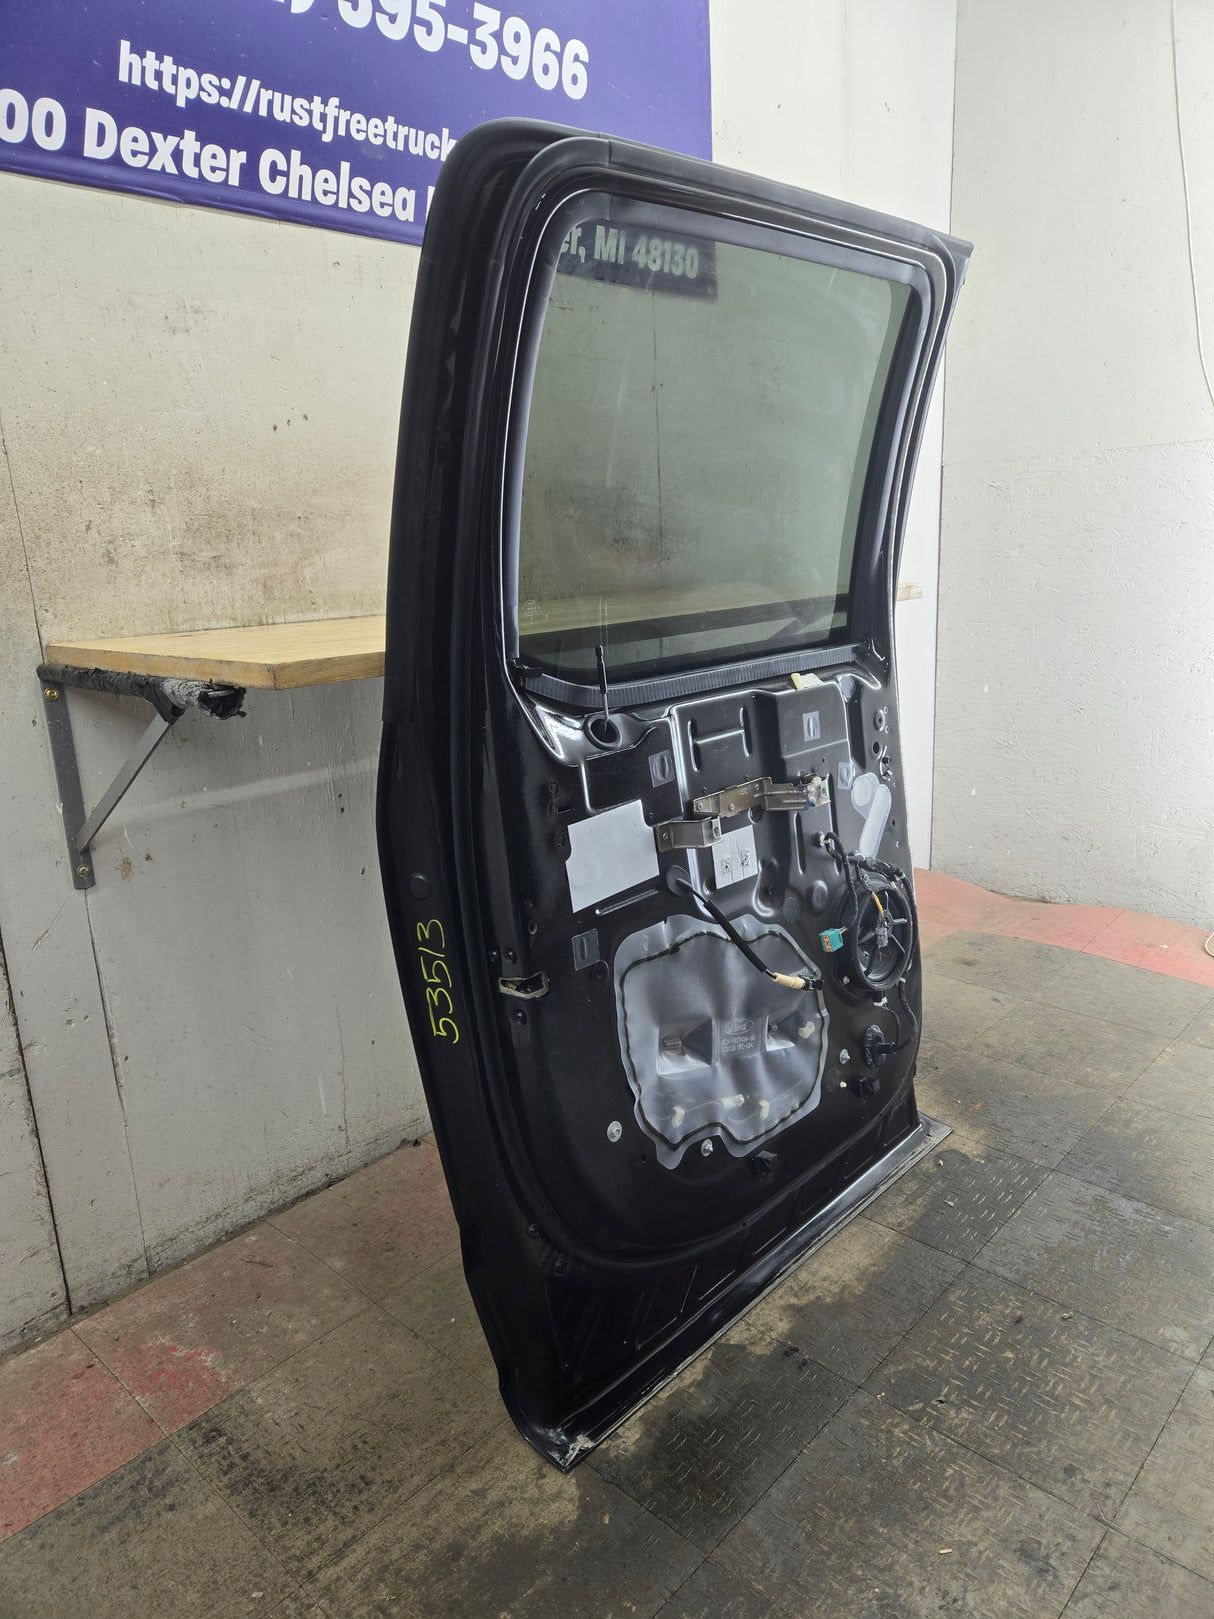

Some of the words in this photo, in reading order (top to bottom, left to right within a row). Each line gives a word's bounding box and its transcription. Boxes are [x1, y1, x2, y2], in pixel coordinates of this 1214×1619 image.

[0, 88, 67, 151] 00
[84, 107, 247, 186] Dexter
[259, 148, 416, 223] Chelsea
[594, 225, 626, 264] MI
[631, 235, 699, 279] 48130
[416, 919, 459, 1044] 53513
